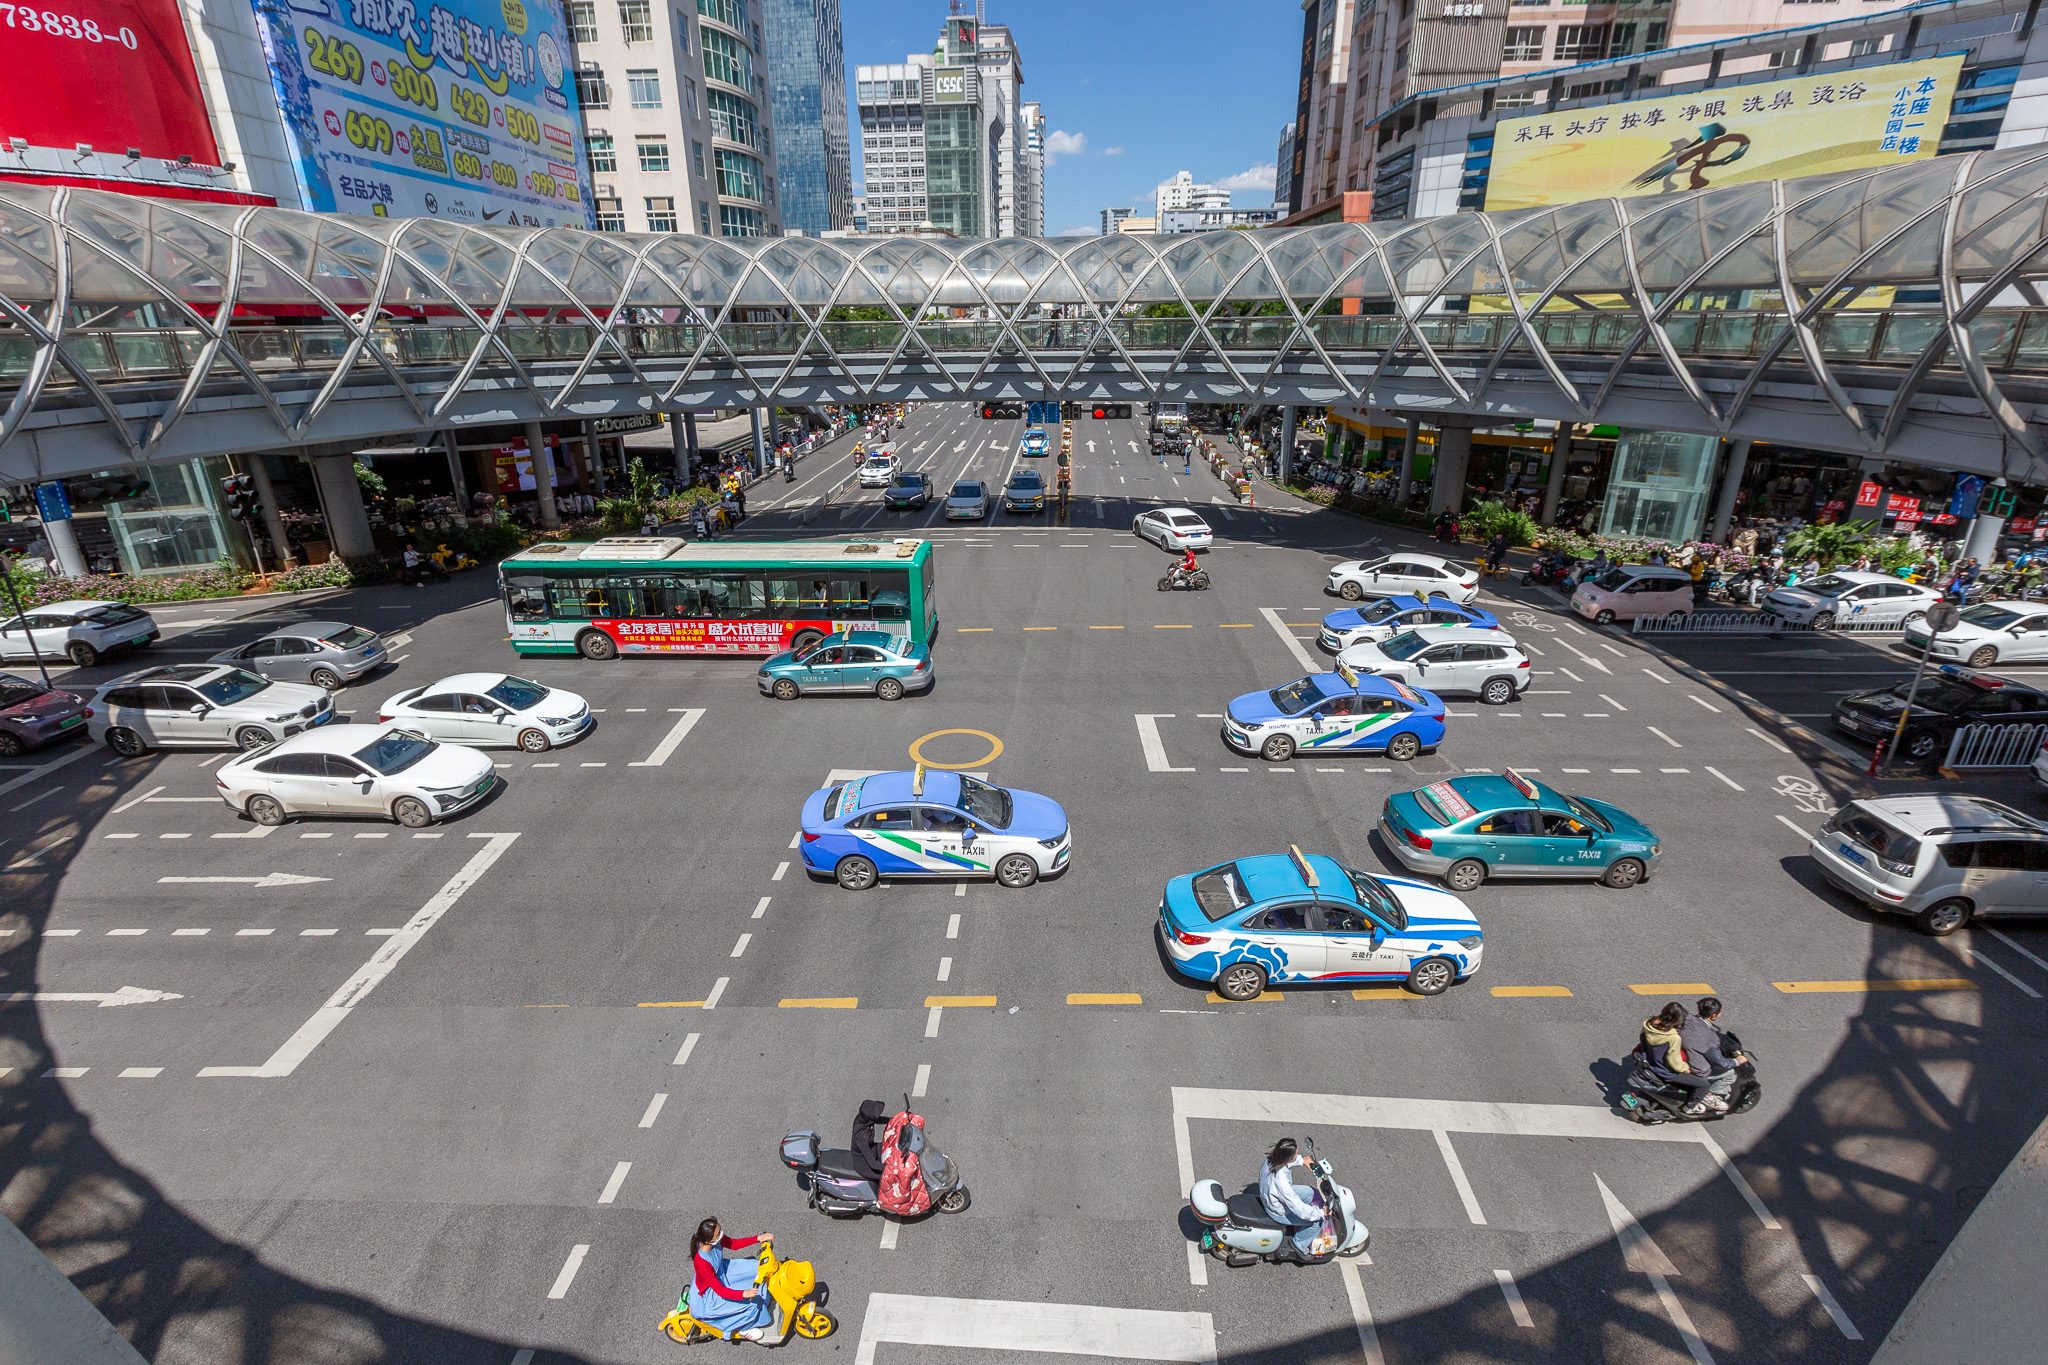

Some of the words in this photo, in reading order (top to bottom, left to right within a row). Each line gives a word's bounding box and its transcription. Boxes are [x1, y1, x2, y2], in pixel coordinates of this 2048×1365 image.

[304, 27, 364, 85] 269
[387, 59, 439, 110] 300
[451, 84, 491, 128] 429
[505, 104, 541, 146] 500
[936, 77, 963, 94] CSSC
[1514, 124, 1554, 142] 采耳
[1565, 116, 1609, 137] 头疗
[1619, 108, 1666, 130] 按摩
[1679, 100, 1726, 121] 净眼
[1742, 90, 1794, 112] 洗鼻
[1808, 81, 1867, 105] 烫浴
[1878, 86, 1911, 151] 小花园店
[1899, 77, 1937, 155] 本座一楼
[345, 108, 394, 155] 699
[409, 123, 443, 157] 大疆
[454, 150, 483, 180] 680
[491, 160, 518, 189] 800
[531, 171, 556, 198] 999
[339, 174, 394, 204] 名品大牌
[447, 207, 475, 218] COACH
[522, 214, 540, 228] FILA
[1987, 488, 2017, 517] 14
[617, 622, 671, 635] 全友家居
[708, 622, 783, 635] 盛大试营业
[1306, 727, 1320, 735] TAXI
[961, 846, 980, 855] TAXI
[1578, 850, 1597, 859] TAXI
[1351, 951, 1373, 959] 云能行
